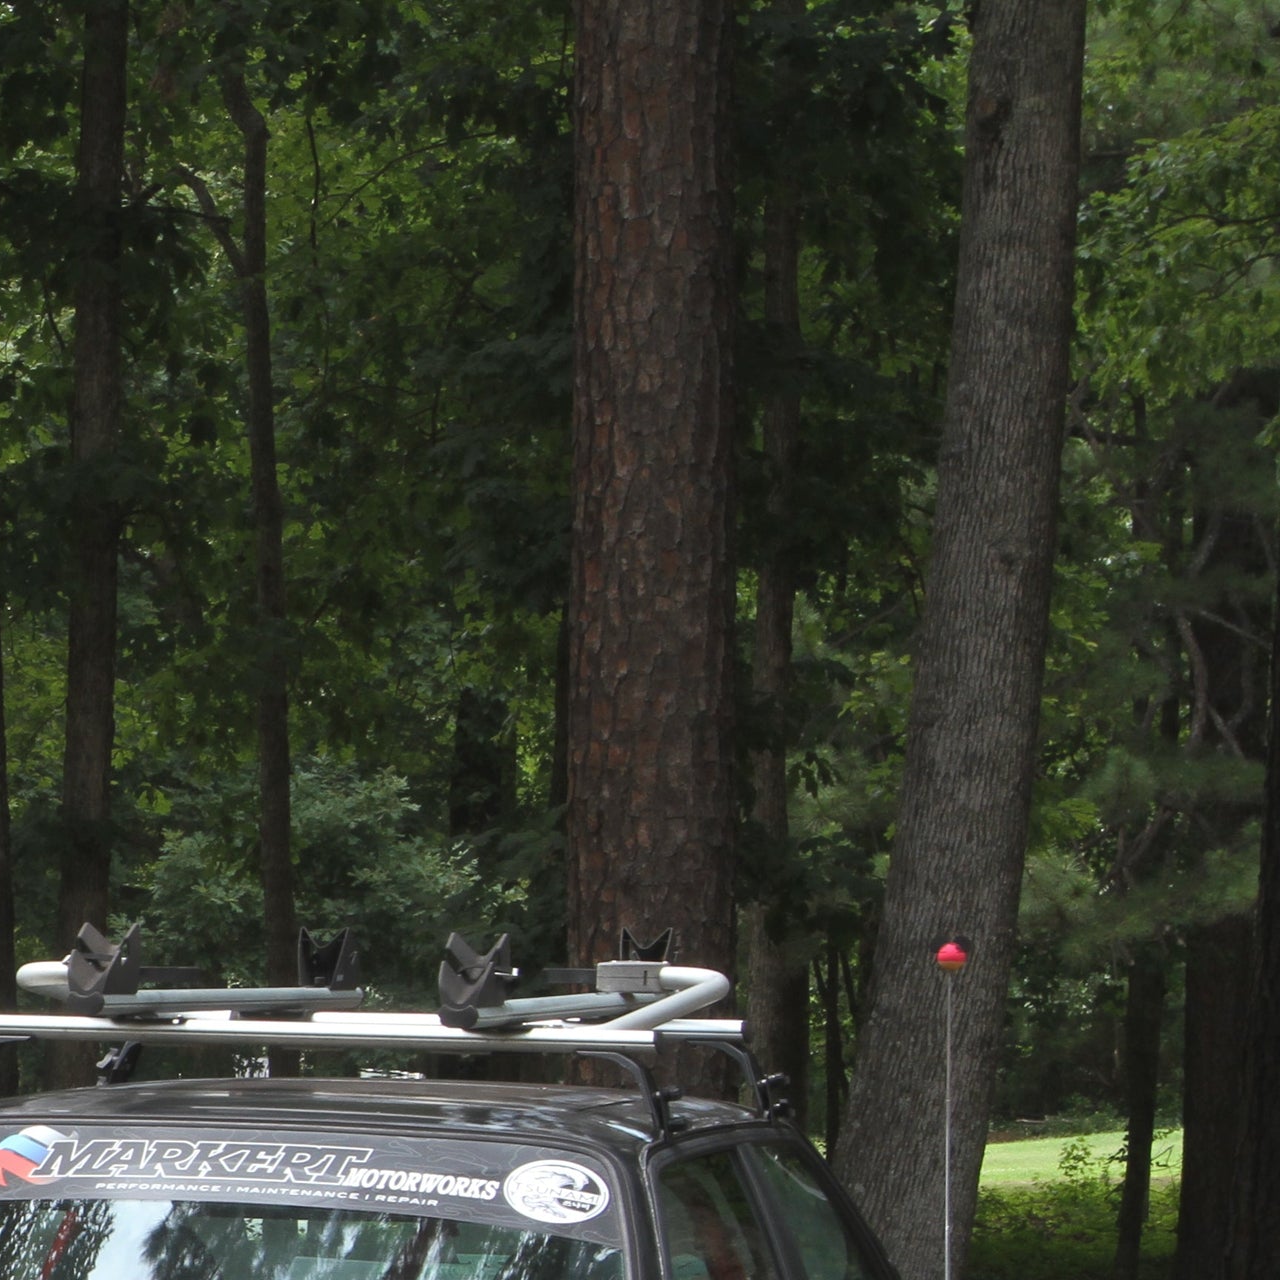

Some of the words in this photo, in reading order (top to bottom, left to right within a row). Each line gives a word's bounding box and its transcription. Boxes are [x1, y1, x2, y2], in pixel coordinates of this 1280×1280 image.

[28, 1139, 374, 1186] MARKERT
[342, 1167, 500, 1201] MOTORWORKS
[95, 1182, 221, 1193] PERFORMANCE
[236, 1186, 360, 1201] MAINTENANCE
[376, 1194, 439, 1207] REPAIR
[515, 1181, 601, 1205] TSUNAMI
